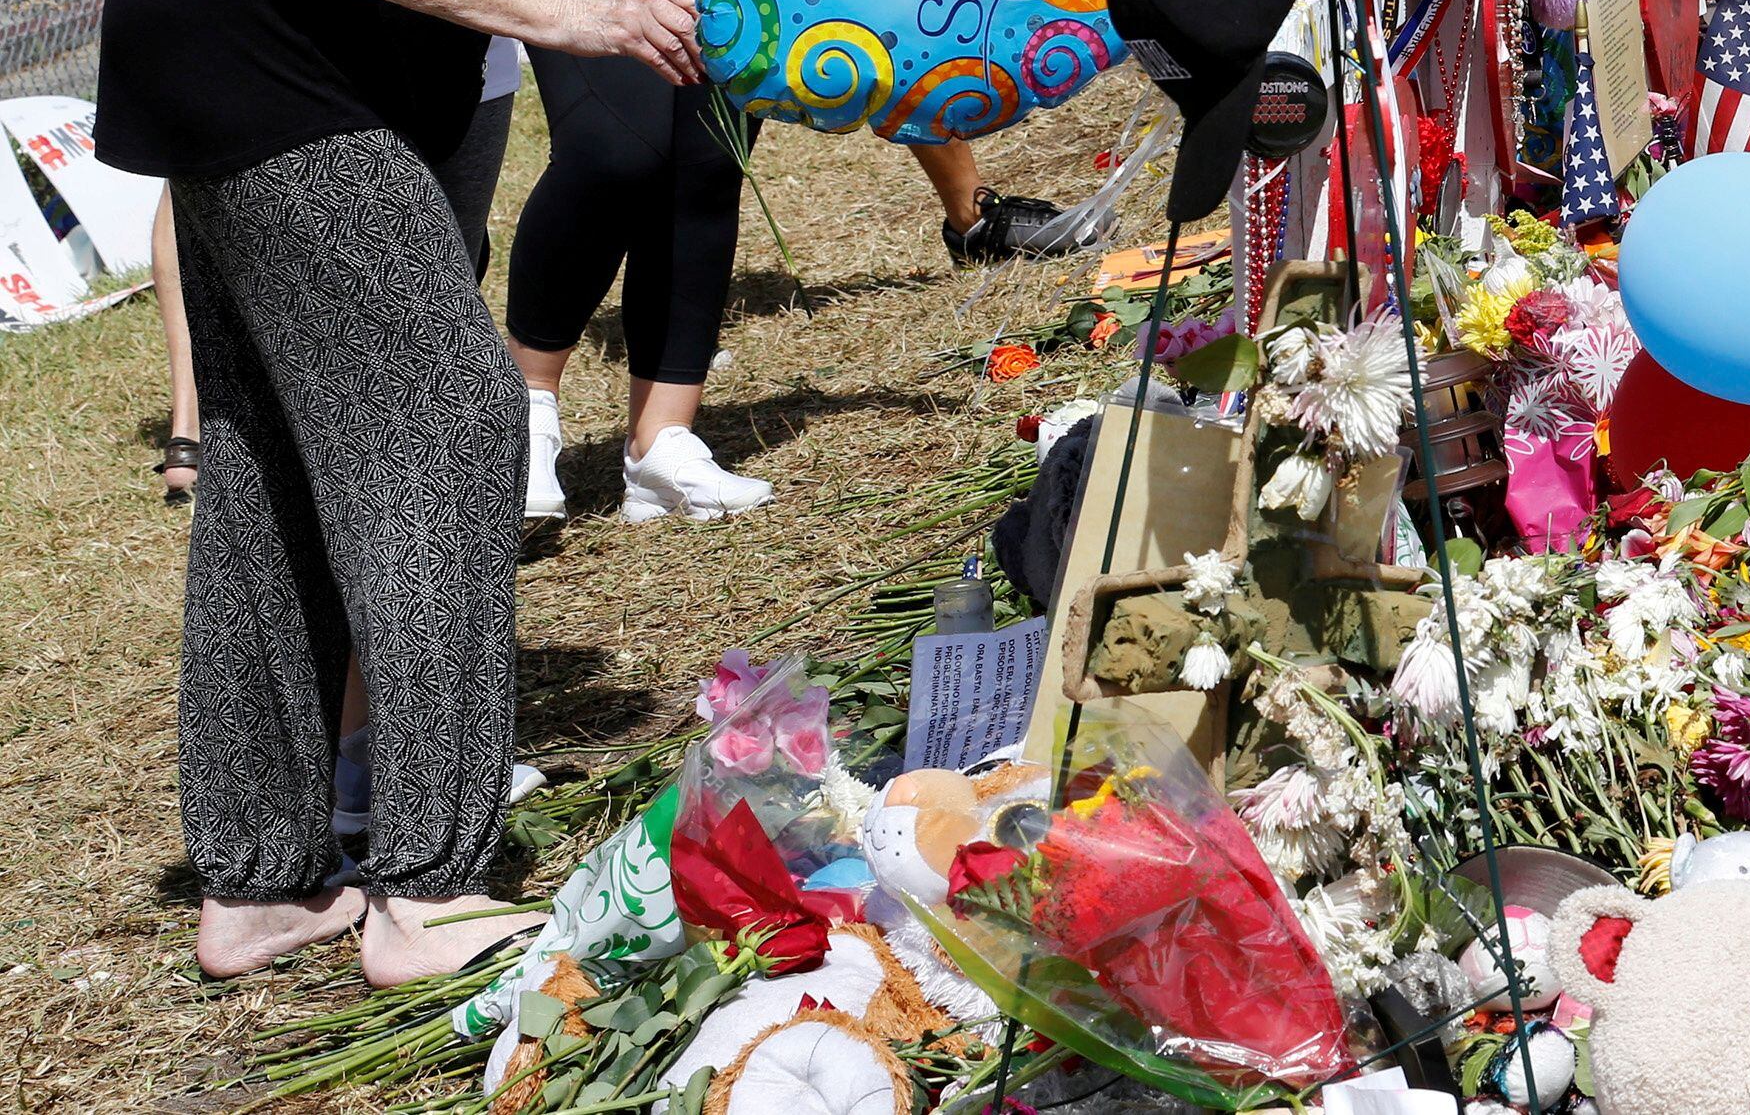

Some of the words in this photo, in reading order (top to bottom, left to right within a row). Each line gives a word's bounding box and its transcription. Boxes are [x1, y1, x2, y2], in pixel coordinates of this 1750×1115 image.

[1259, 81, 1309, 94] DSTRONG
[976, 643, 985, 661] ORA
[942, 646, 952, 690] PROBLEMI
[974, 663, 984, 693] BASTA!
[1006, 666, 1014, 681] ERA
[930, 647, 942, 717] INDISCRIMINATA
[949, 701, 960, 721] DEVE
[926, 719, 936, 743] DEGLI
[993, 732, 1004, 747] CHE
